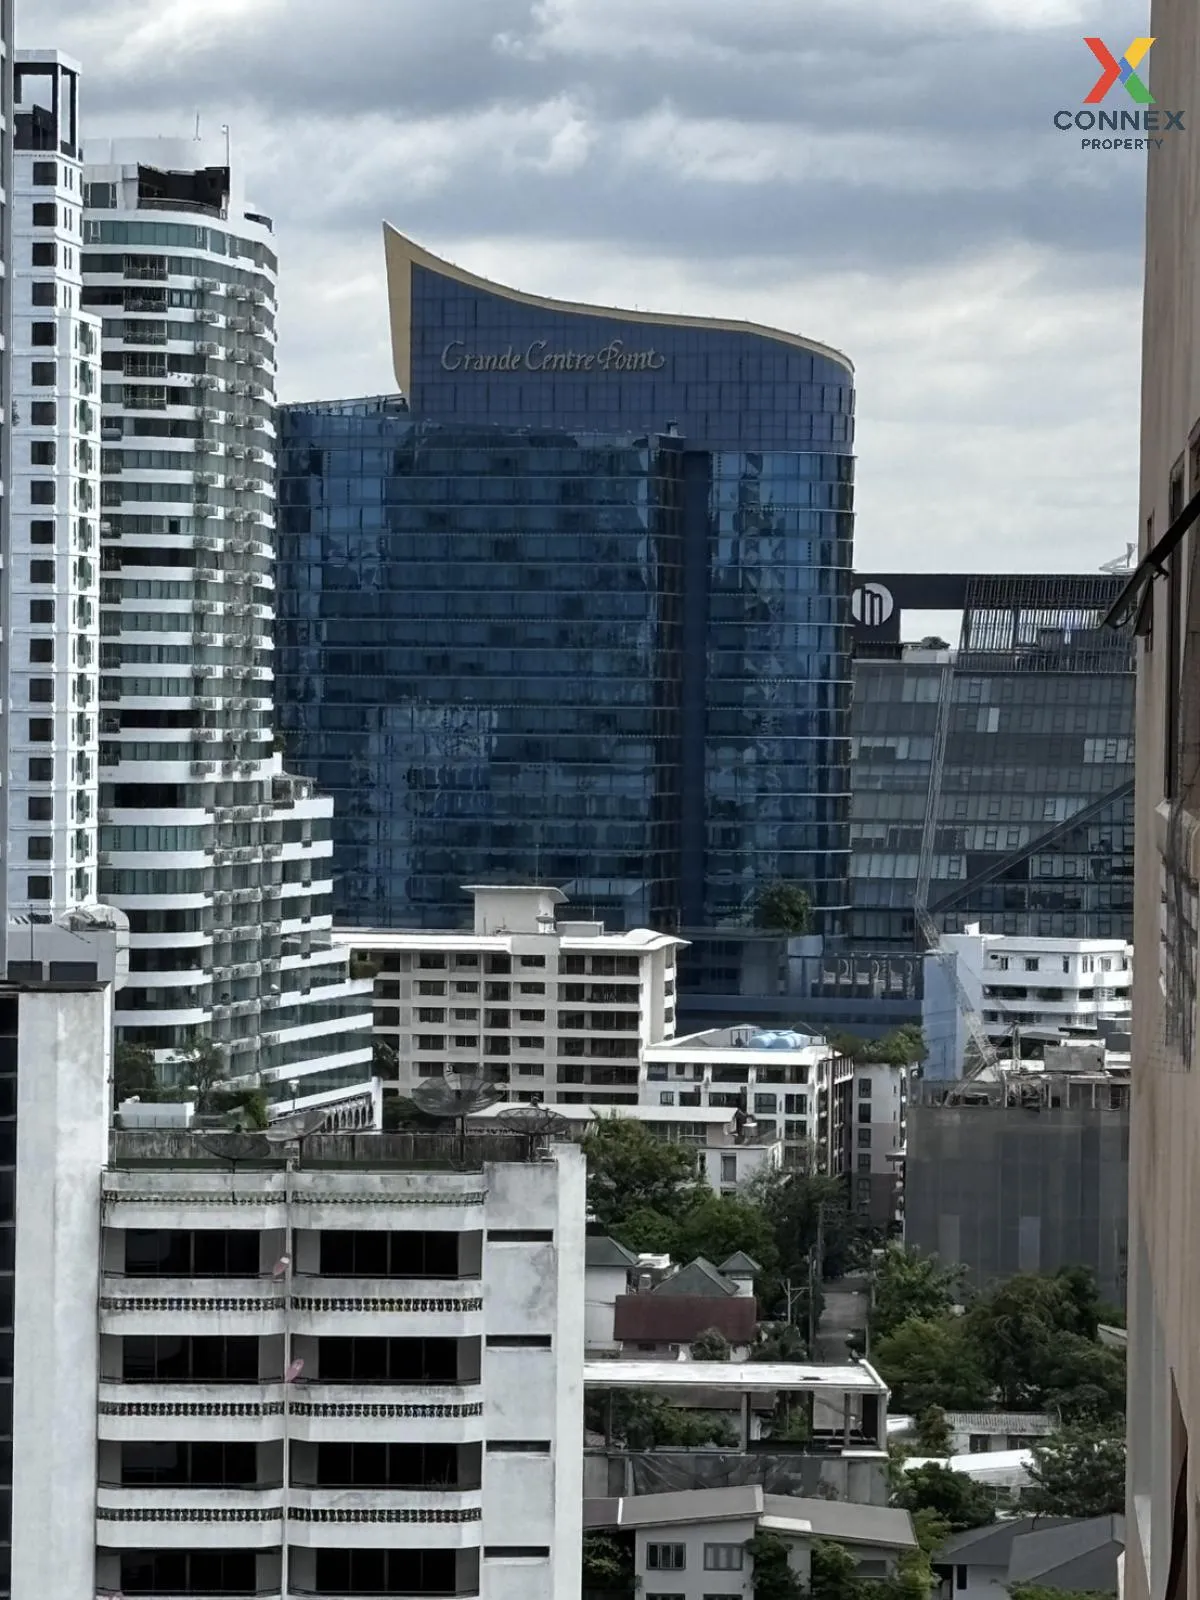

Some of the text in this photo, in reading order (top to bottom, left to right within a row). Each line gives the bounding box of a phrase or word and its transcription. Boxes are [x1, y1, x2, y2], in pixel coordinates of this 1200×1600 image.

[441, 339, 665, 371] Grande Centre Point
